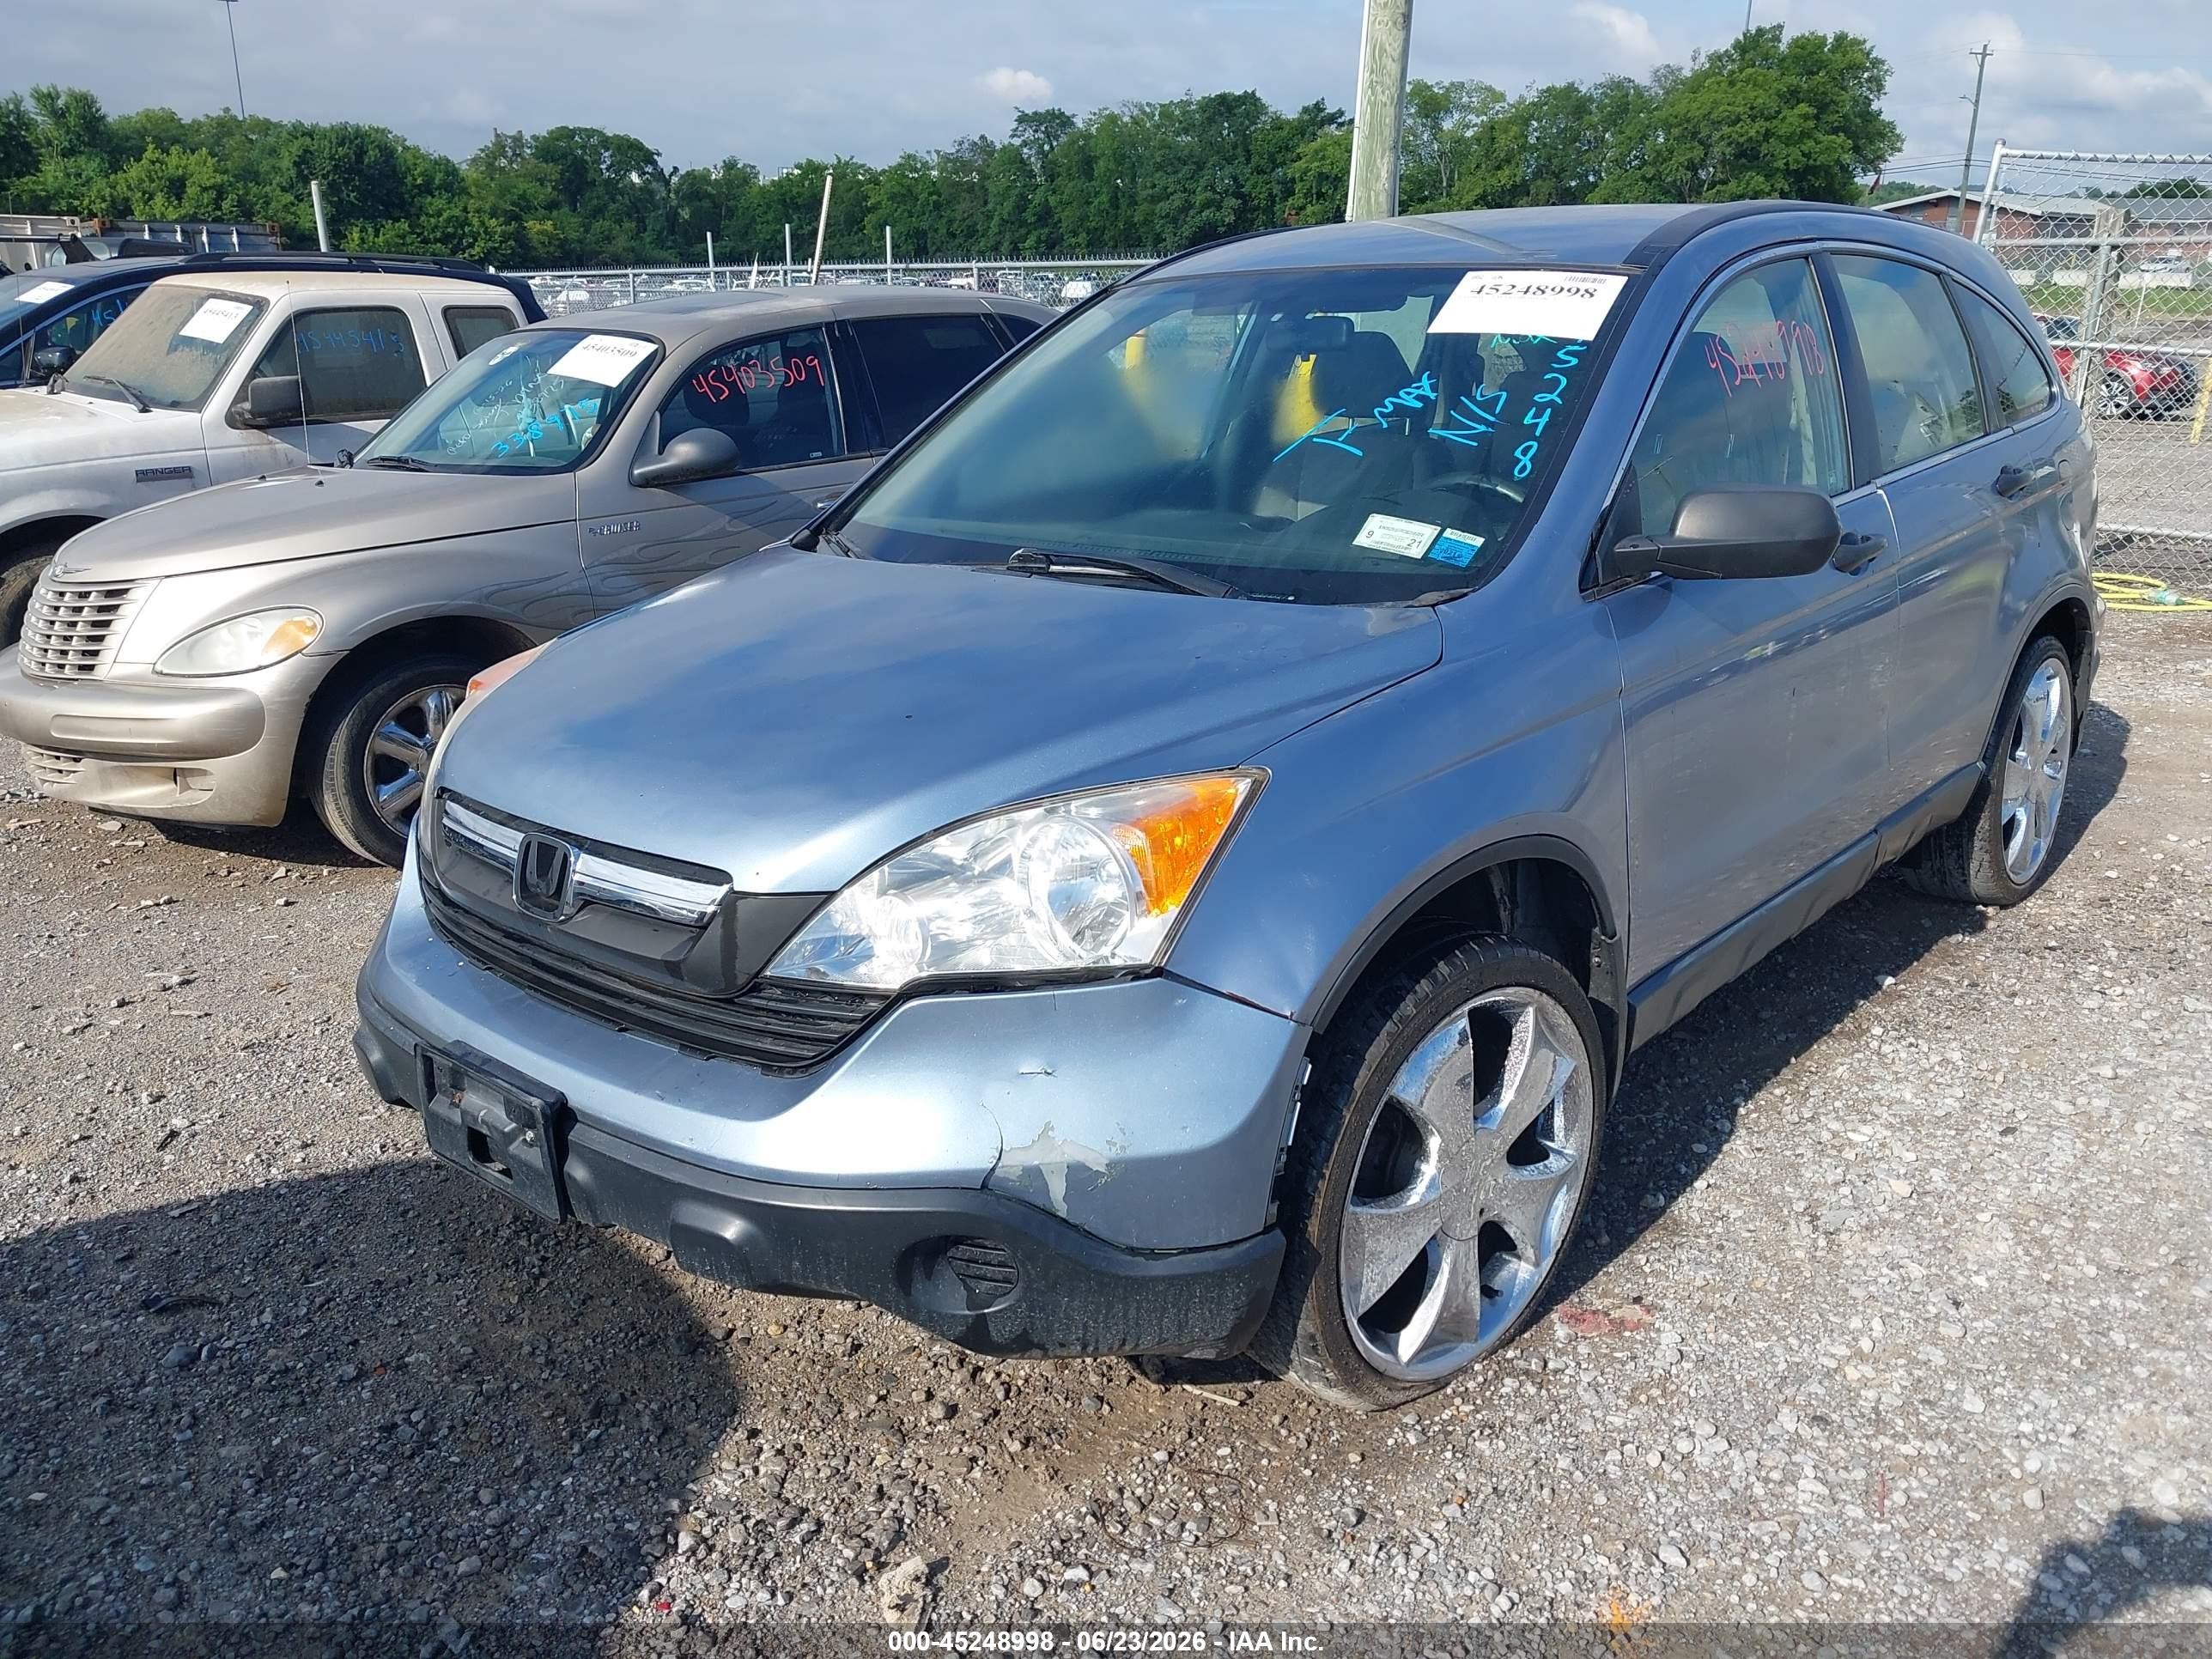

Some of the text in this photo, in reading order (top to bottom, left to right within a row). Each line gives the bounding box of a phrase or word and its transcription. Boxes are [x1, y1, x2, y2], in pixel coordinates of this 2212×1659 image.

[1469, 284, 1598, 300] 45248998
[692, 356, 824, 403] 45403509
[135, 465, 192, 477] RANGER
[599, 520, 641, 536] CRUISER
[1365, 530, 1375, 539] 9
[1407, 538, 1423, 550] 21
